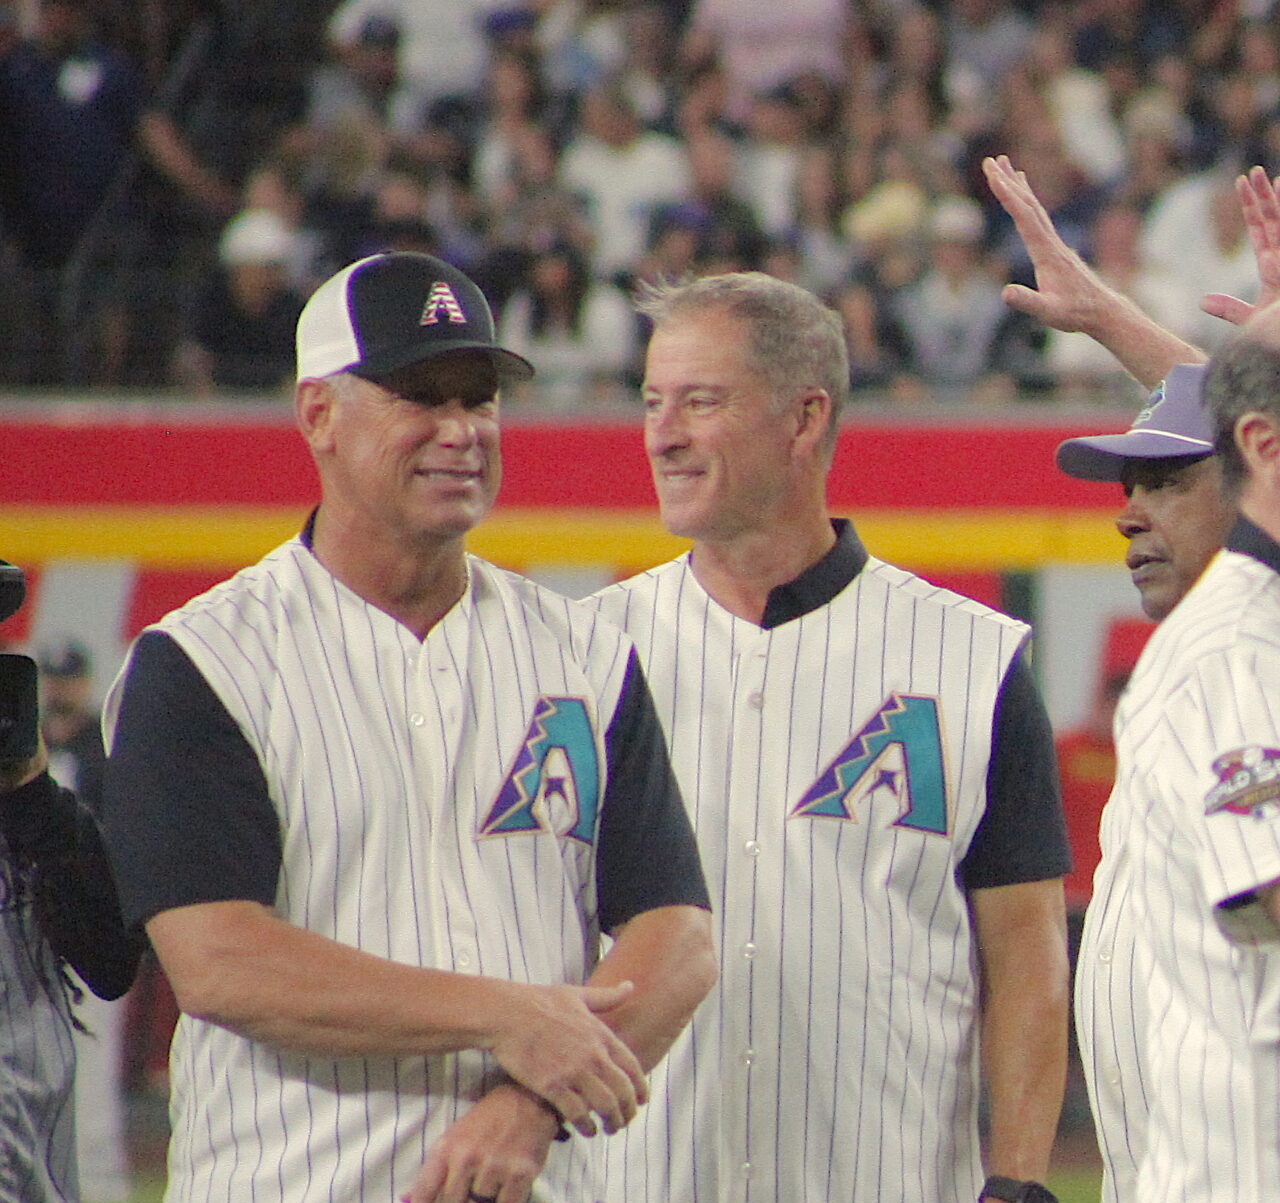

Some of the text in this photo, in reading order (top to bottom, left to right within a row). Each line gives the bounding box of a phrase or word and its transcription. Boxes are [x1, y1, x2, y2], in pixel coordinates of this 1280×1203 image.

[419, 281, 467, 326] A
[473, 694, 600, 847] A
[786, 690, 954, 842] A
